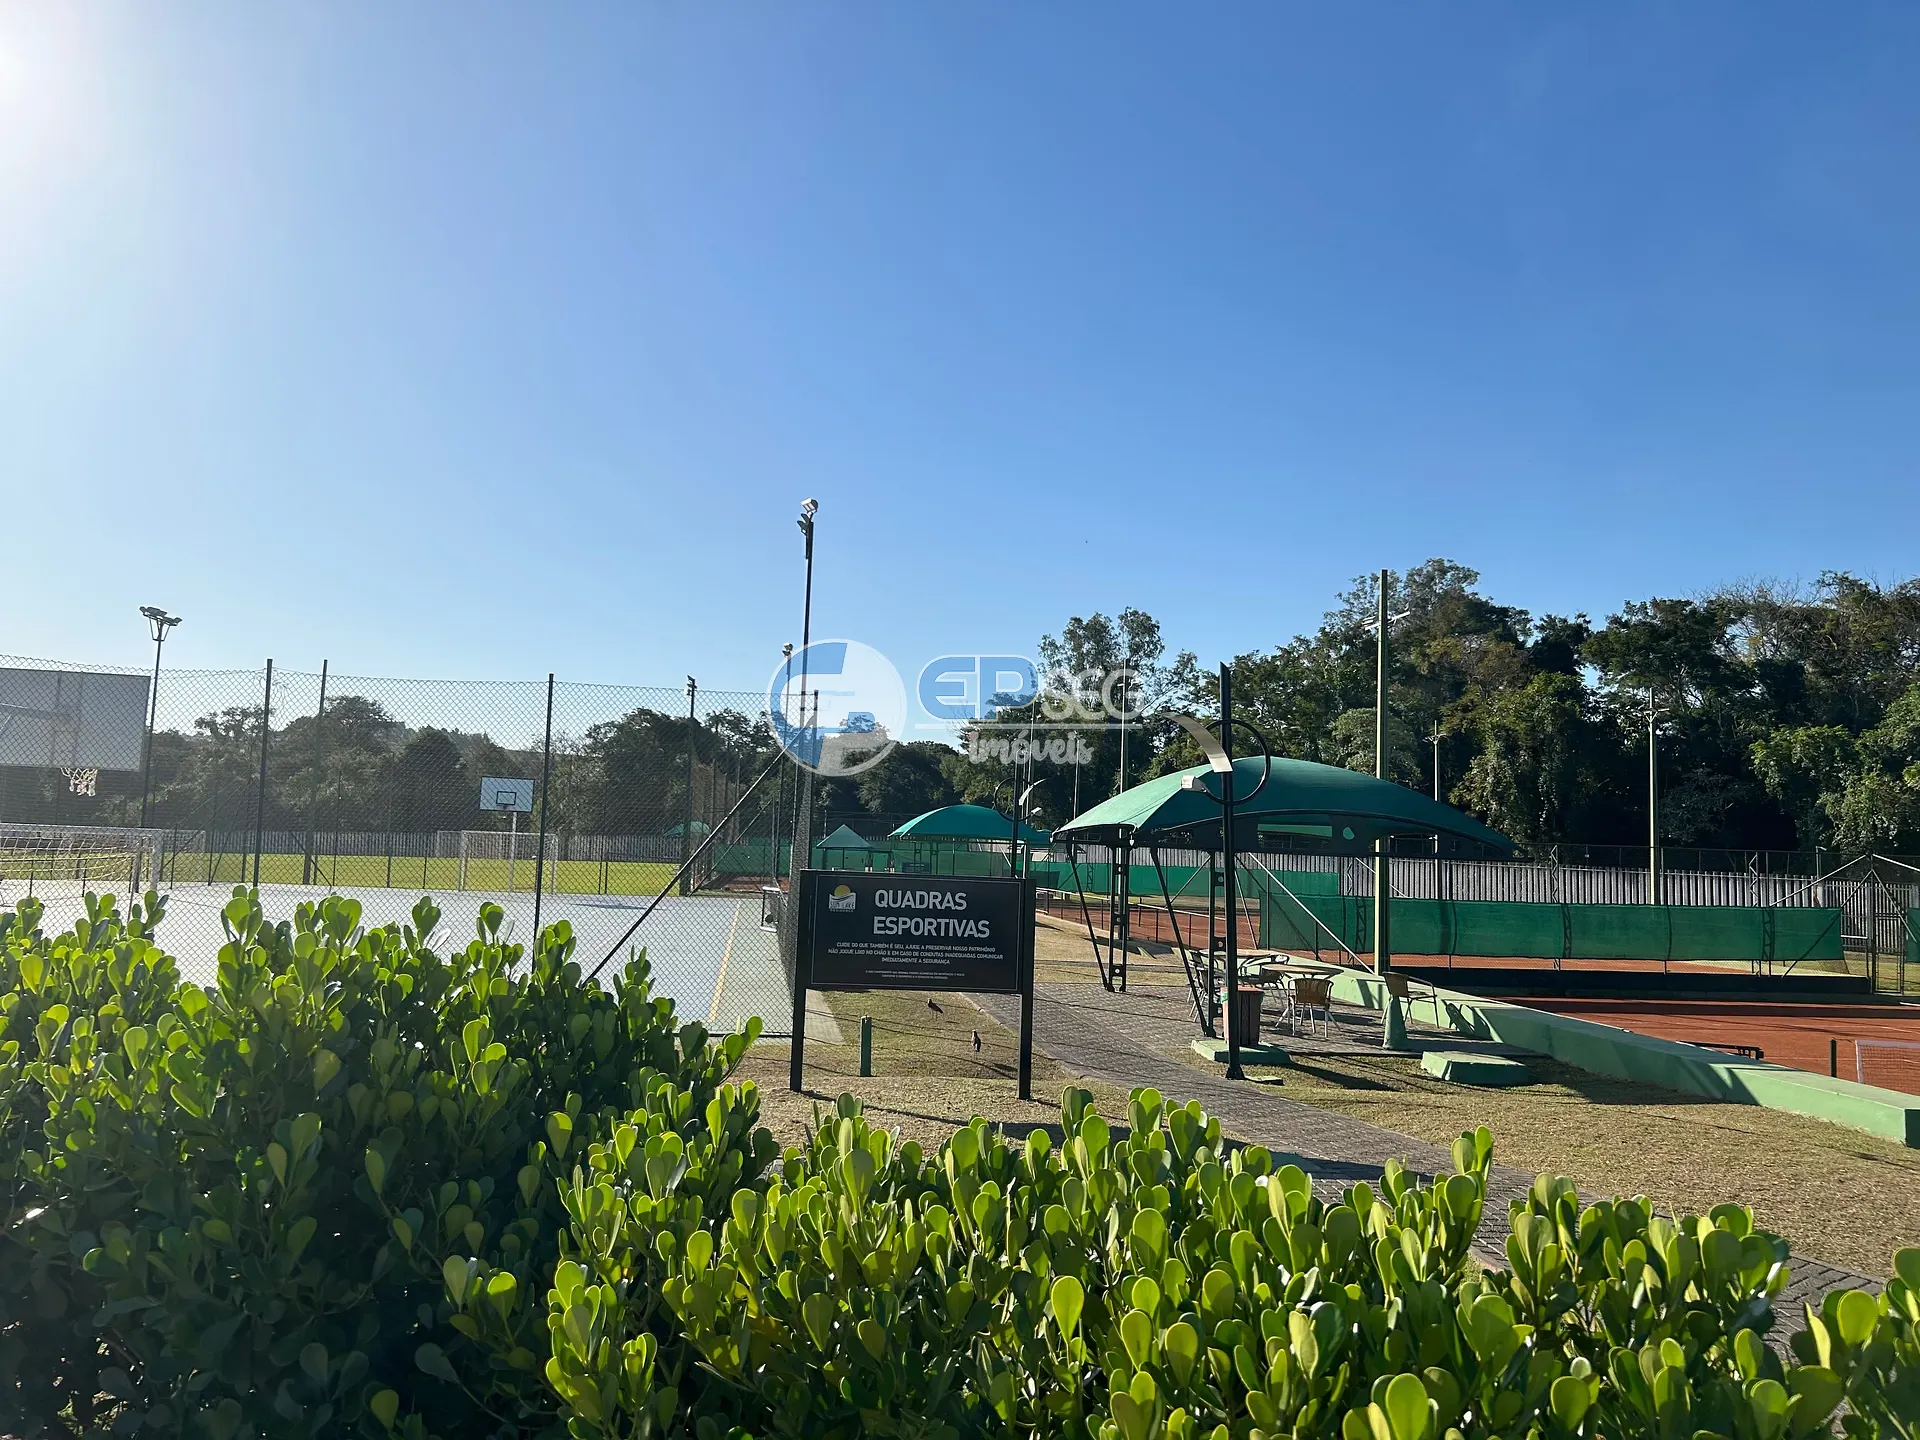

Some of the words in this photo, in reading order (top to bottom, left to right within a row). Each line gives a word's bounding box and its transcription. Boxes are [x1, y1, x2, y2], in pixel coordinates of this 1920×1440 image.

[875, 889, 967, 911] QUADRAS
[873, 916, 990, 938] ESPORTIVAS
[869, 941, 889, 949] TAMBÉM
[874, 948, 887, 956] CHÃO
